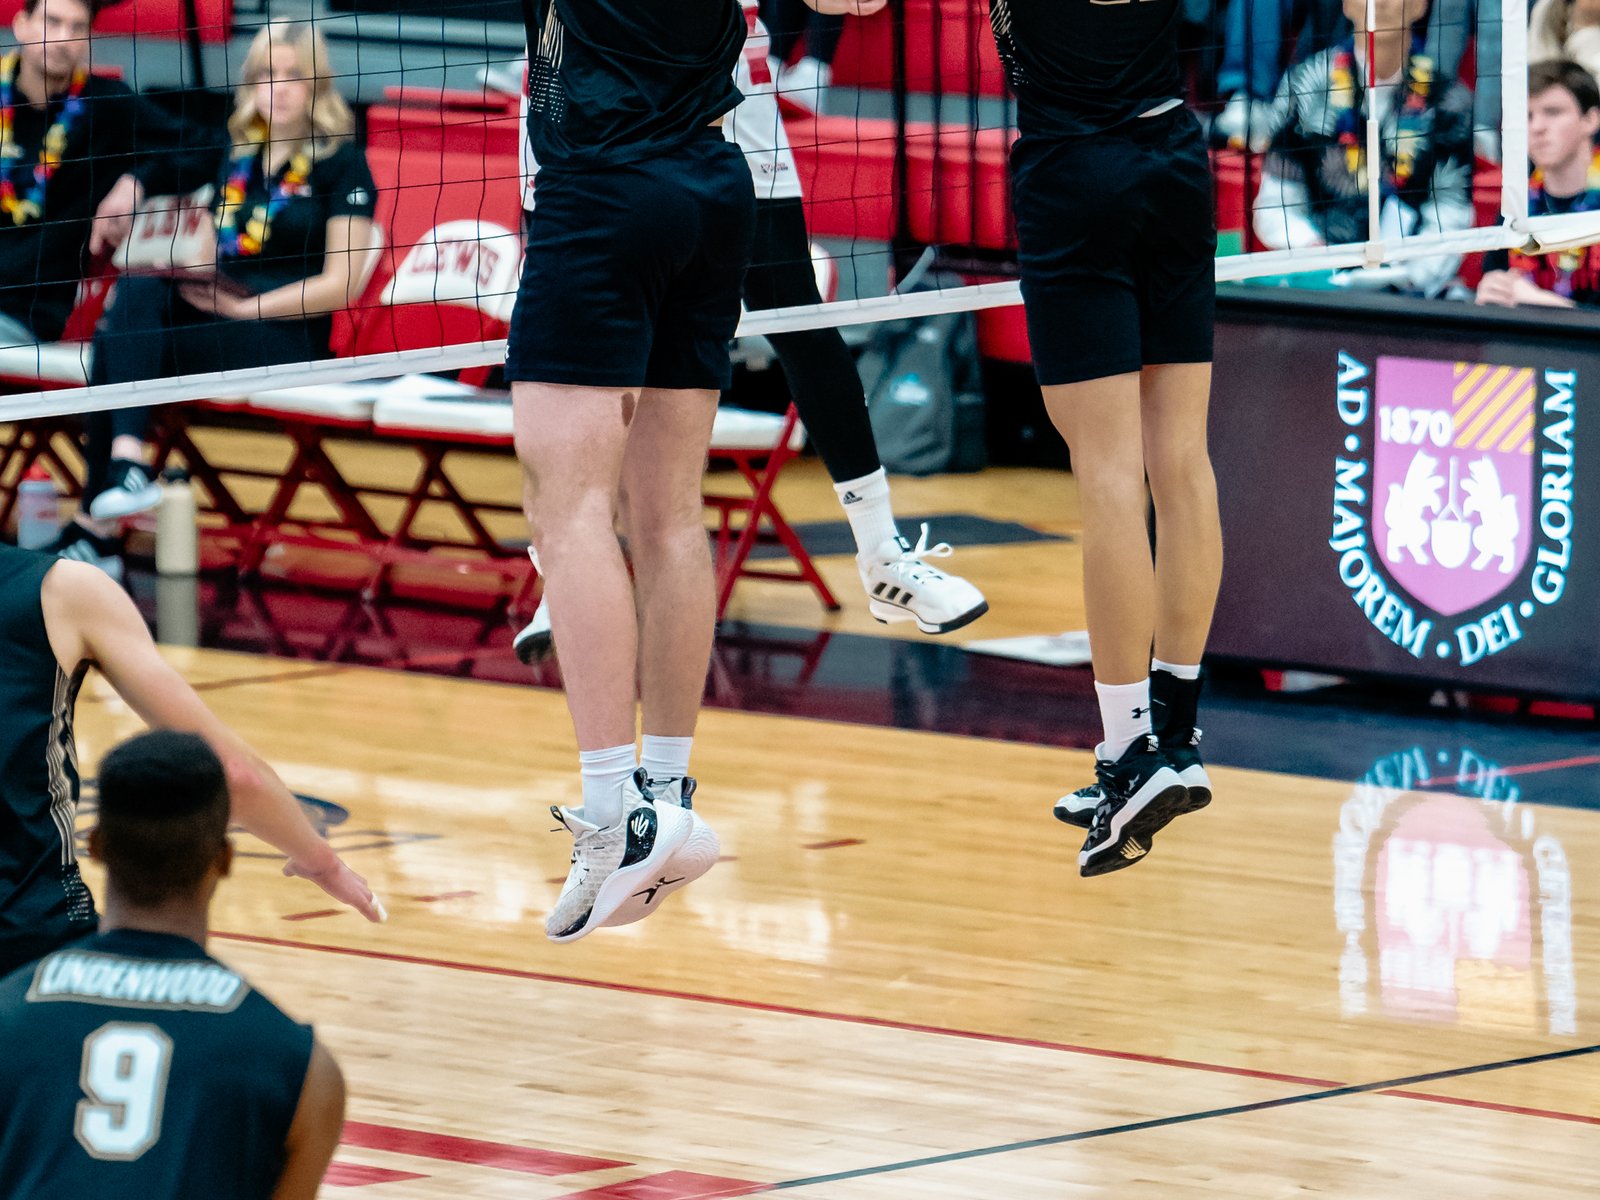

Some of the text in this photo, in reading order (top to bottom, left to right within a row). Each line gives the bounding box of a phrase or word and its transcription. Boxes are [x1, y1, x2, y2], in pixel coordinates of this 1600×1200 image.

[1379, 404, 1453, 448] 1870
[1329, 351, 1578, 667] AD MAJOREM DEI GLORIAM
[38, 953, 242, 1007] LINDENWOOD
[74, 1020, 174, 1162] 9
